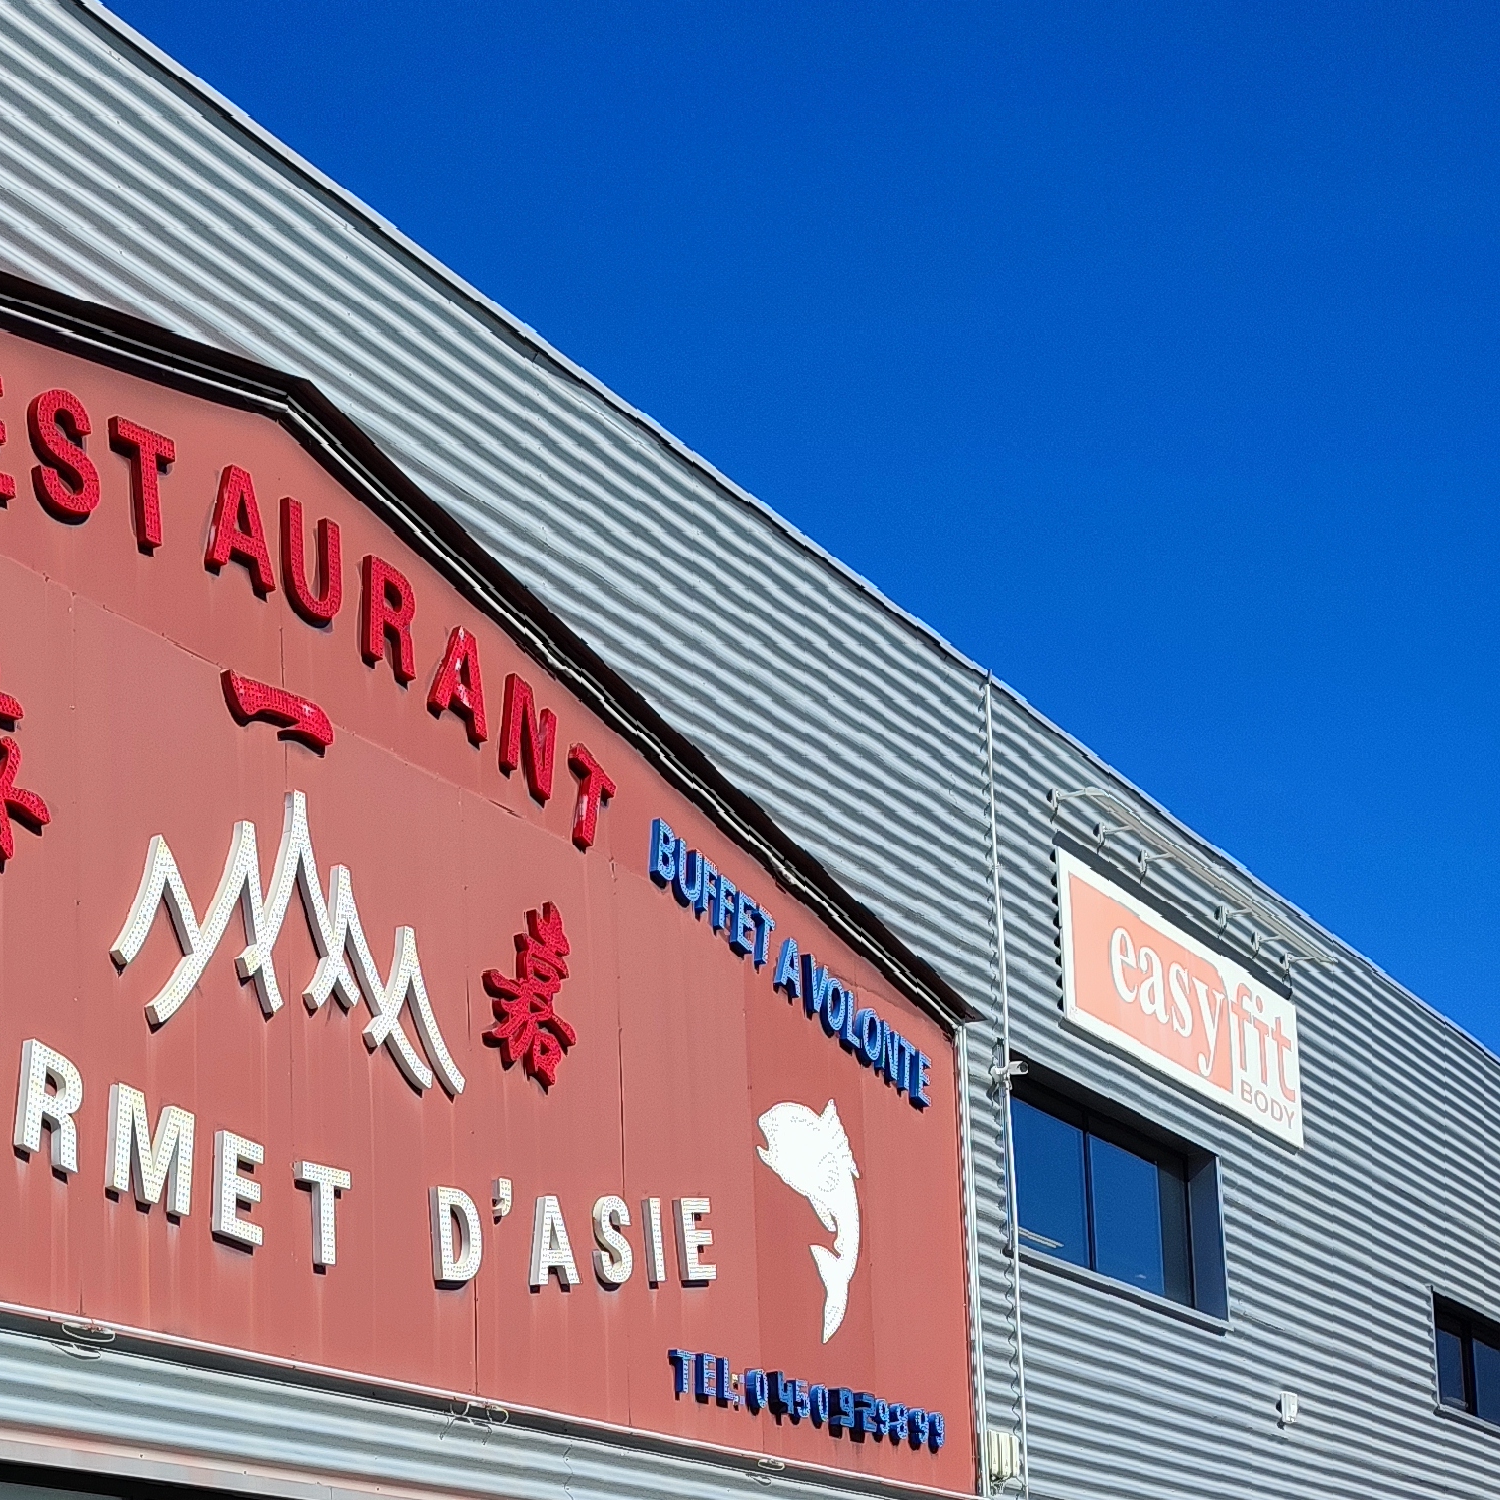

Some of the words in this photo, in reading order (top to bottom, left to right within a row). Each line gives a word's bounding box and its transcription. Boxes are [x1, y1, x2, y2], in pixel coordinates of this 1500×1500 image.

[650, 818, 775, 967] BUFFET
[774, 937, 800, 1000] A
[800, 953, 931, 1108] VOLONTE
[1241, 1079, 1295, 1129] BODY
[428, 1177, 717, 1288] D'ASIE
